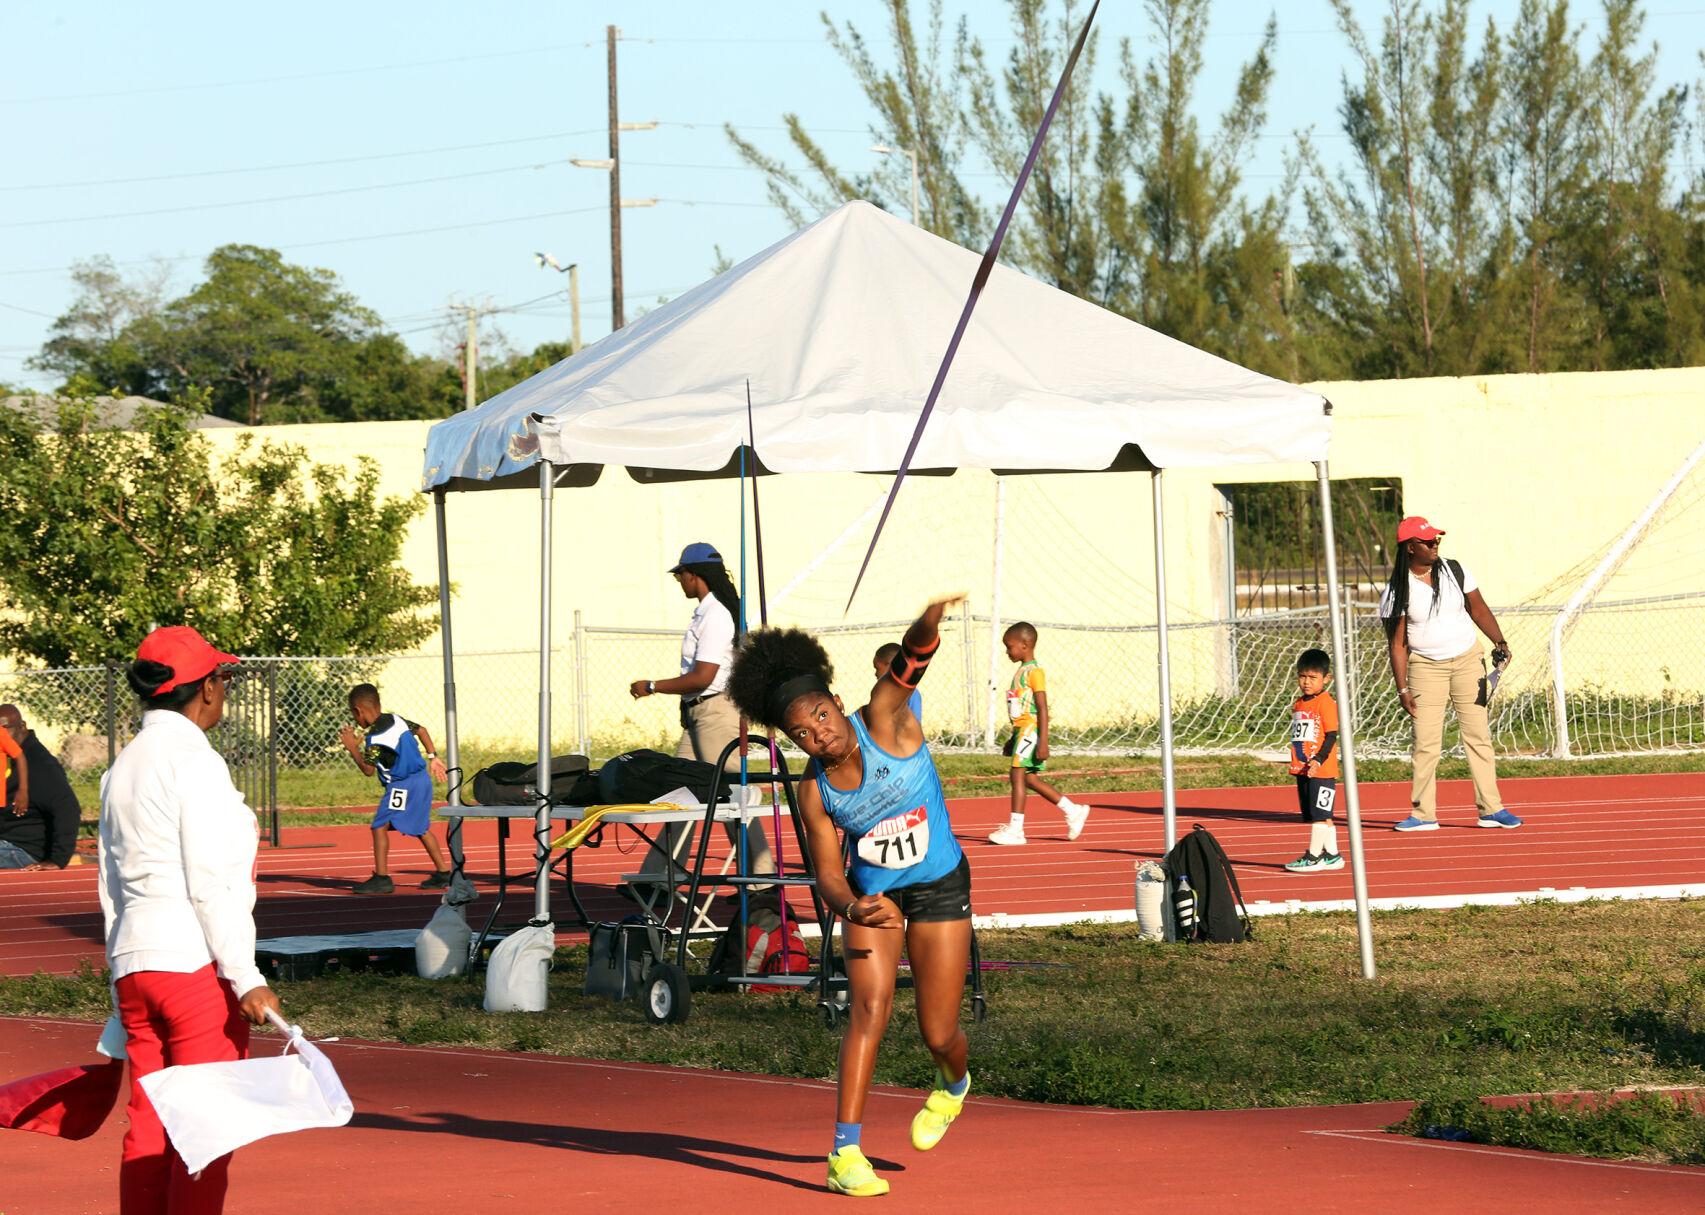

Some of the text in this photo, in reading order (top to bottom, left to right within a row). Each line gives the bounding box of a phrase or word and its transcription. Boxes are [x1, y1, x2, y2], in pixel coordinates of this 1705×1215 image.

[1019, 739, 1033, 754] 7
[391, 789, 404, 809] 5
[836, 776, 904, 826] Blue Chip
[1318, 788, 1332, 808] 3
[874, 832, 917, 864] 711
